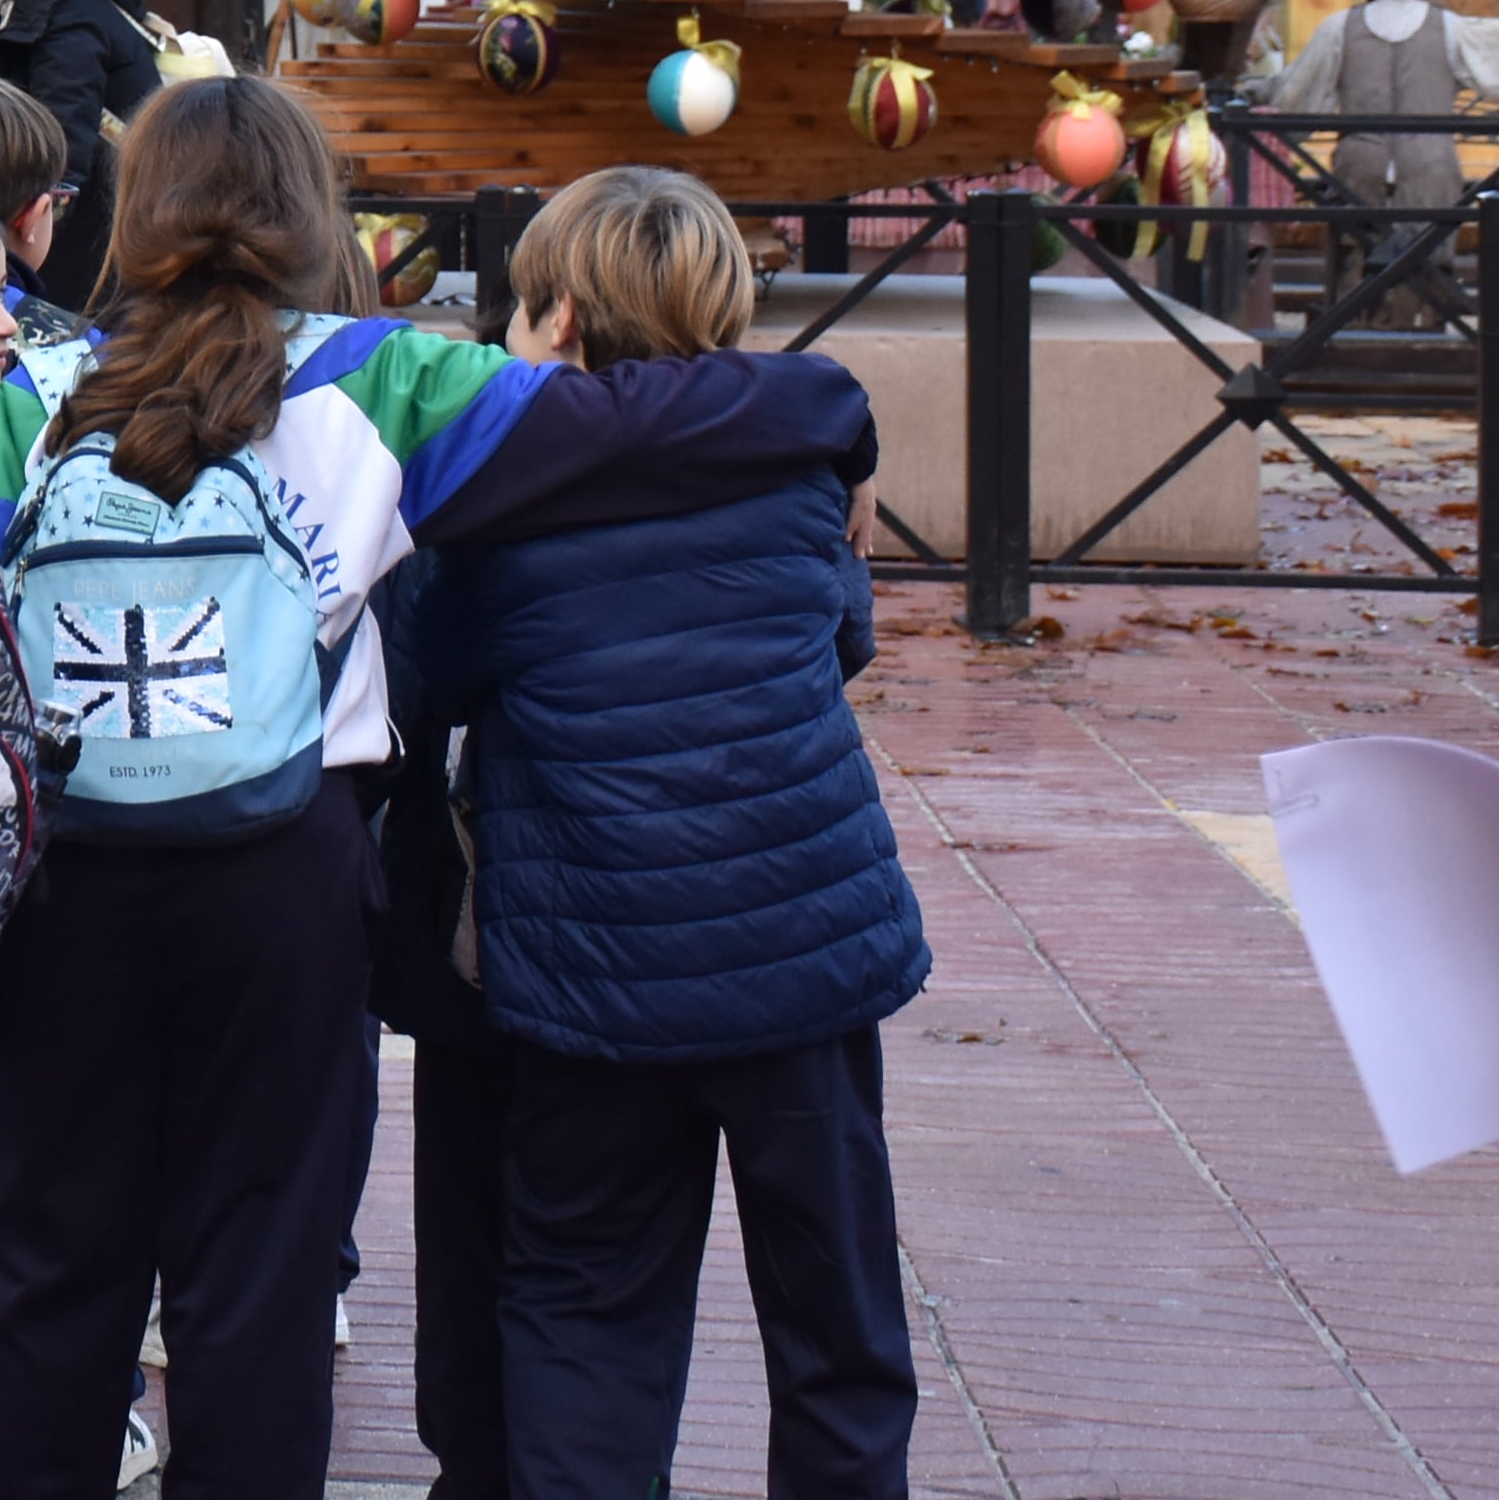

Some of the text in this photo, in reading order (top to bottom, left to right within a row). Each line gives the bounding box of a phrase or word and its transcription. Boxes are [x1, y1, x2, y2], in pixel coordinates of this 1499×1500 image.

[73, 577, 196, 602] PEPE JEANS
[142, 763, 172, 779] 1973
